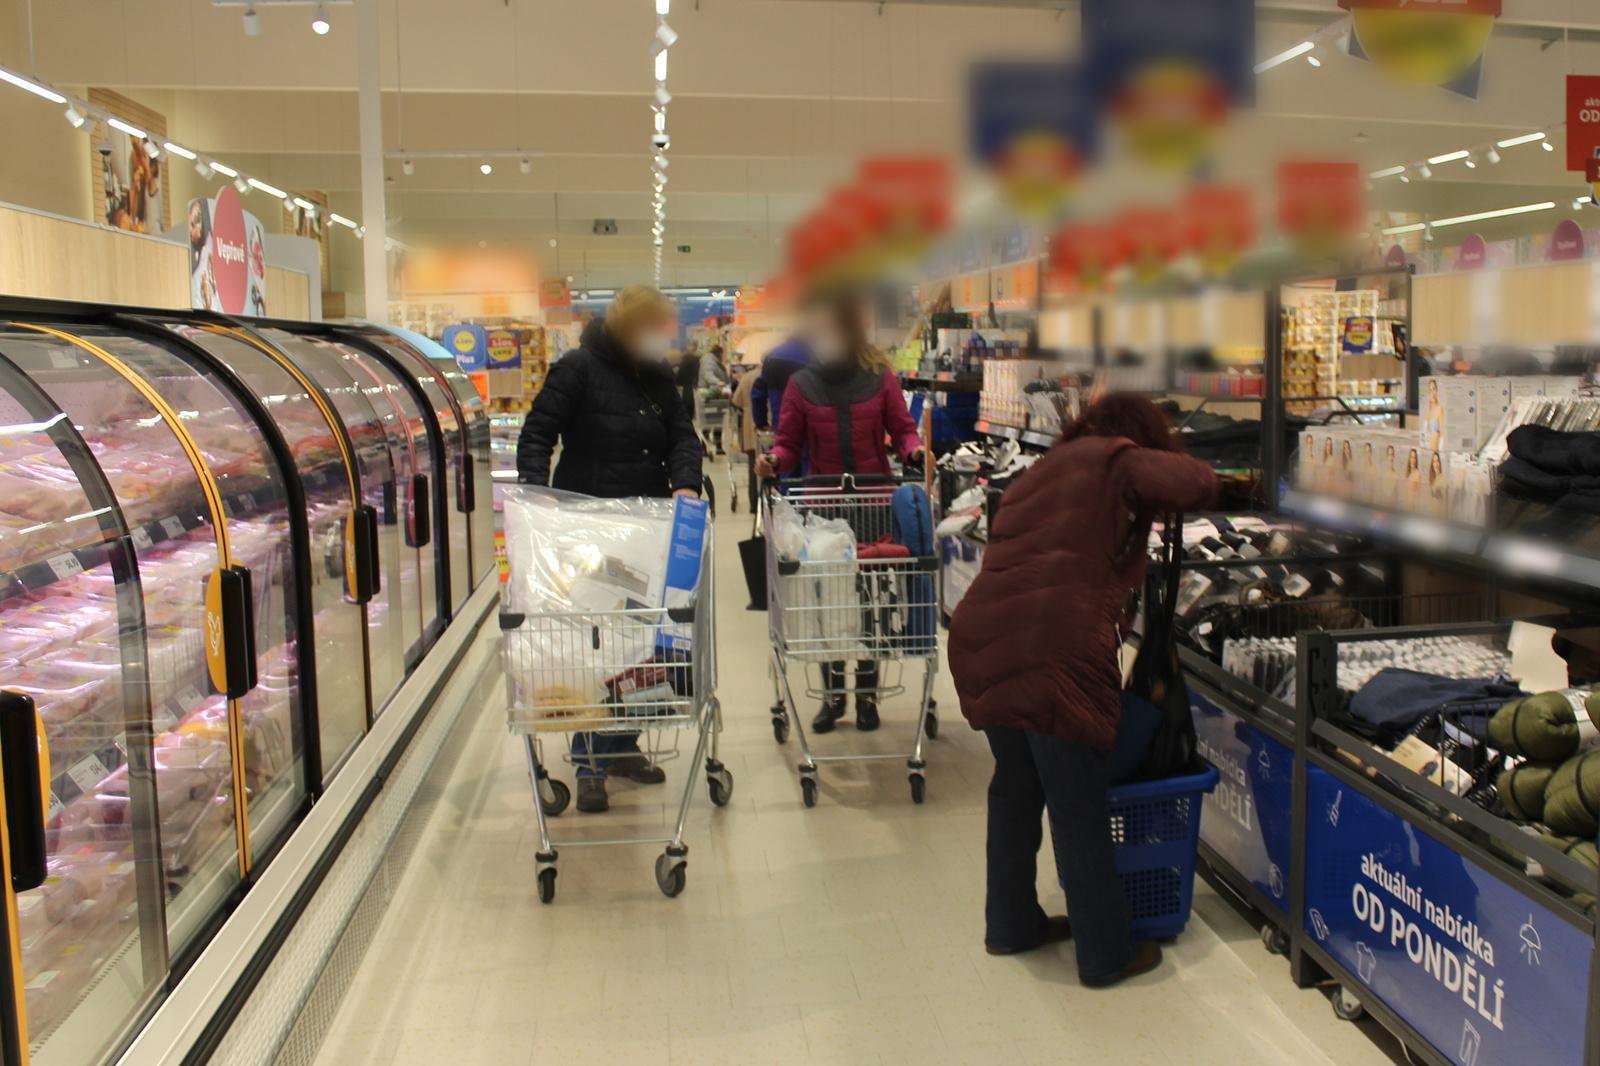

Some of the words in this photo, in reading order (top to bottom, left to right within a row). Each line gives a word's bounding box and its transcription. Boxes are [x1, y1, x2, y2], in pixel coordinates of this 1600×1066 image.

[1580, 109, 1600, 122] OD
[216, 236, 245, 264] Vepřové
[1361, 852, 1422, 913] aktuální
[1425, 897, 1495, 967] nabídka
[1352, 882, 1385, 933] OD
[1390, 908, 1505, 1031] PONDĚLÍ
